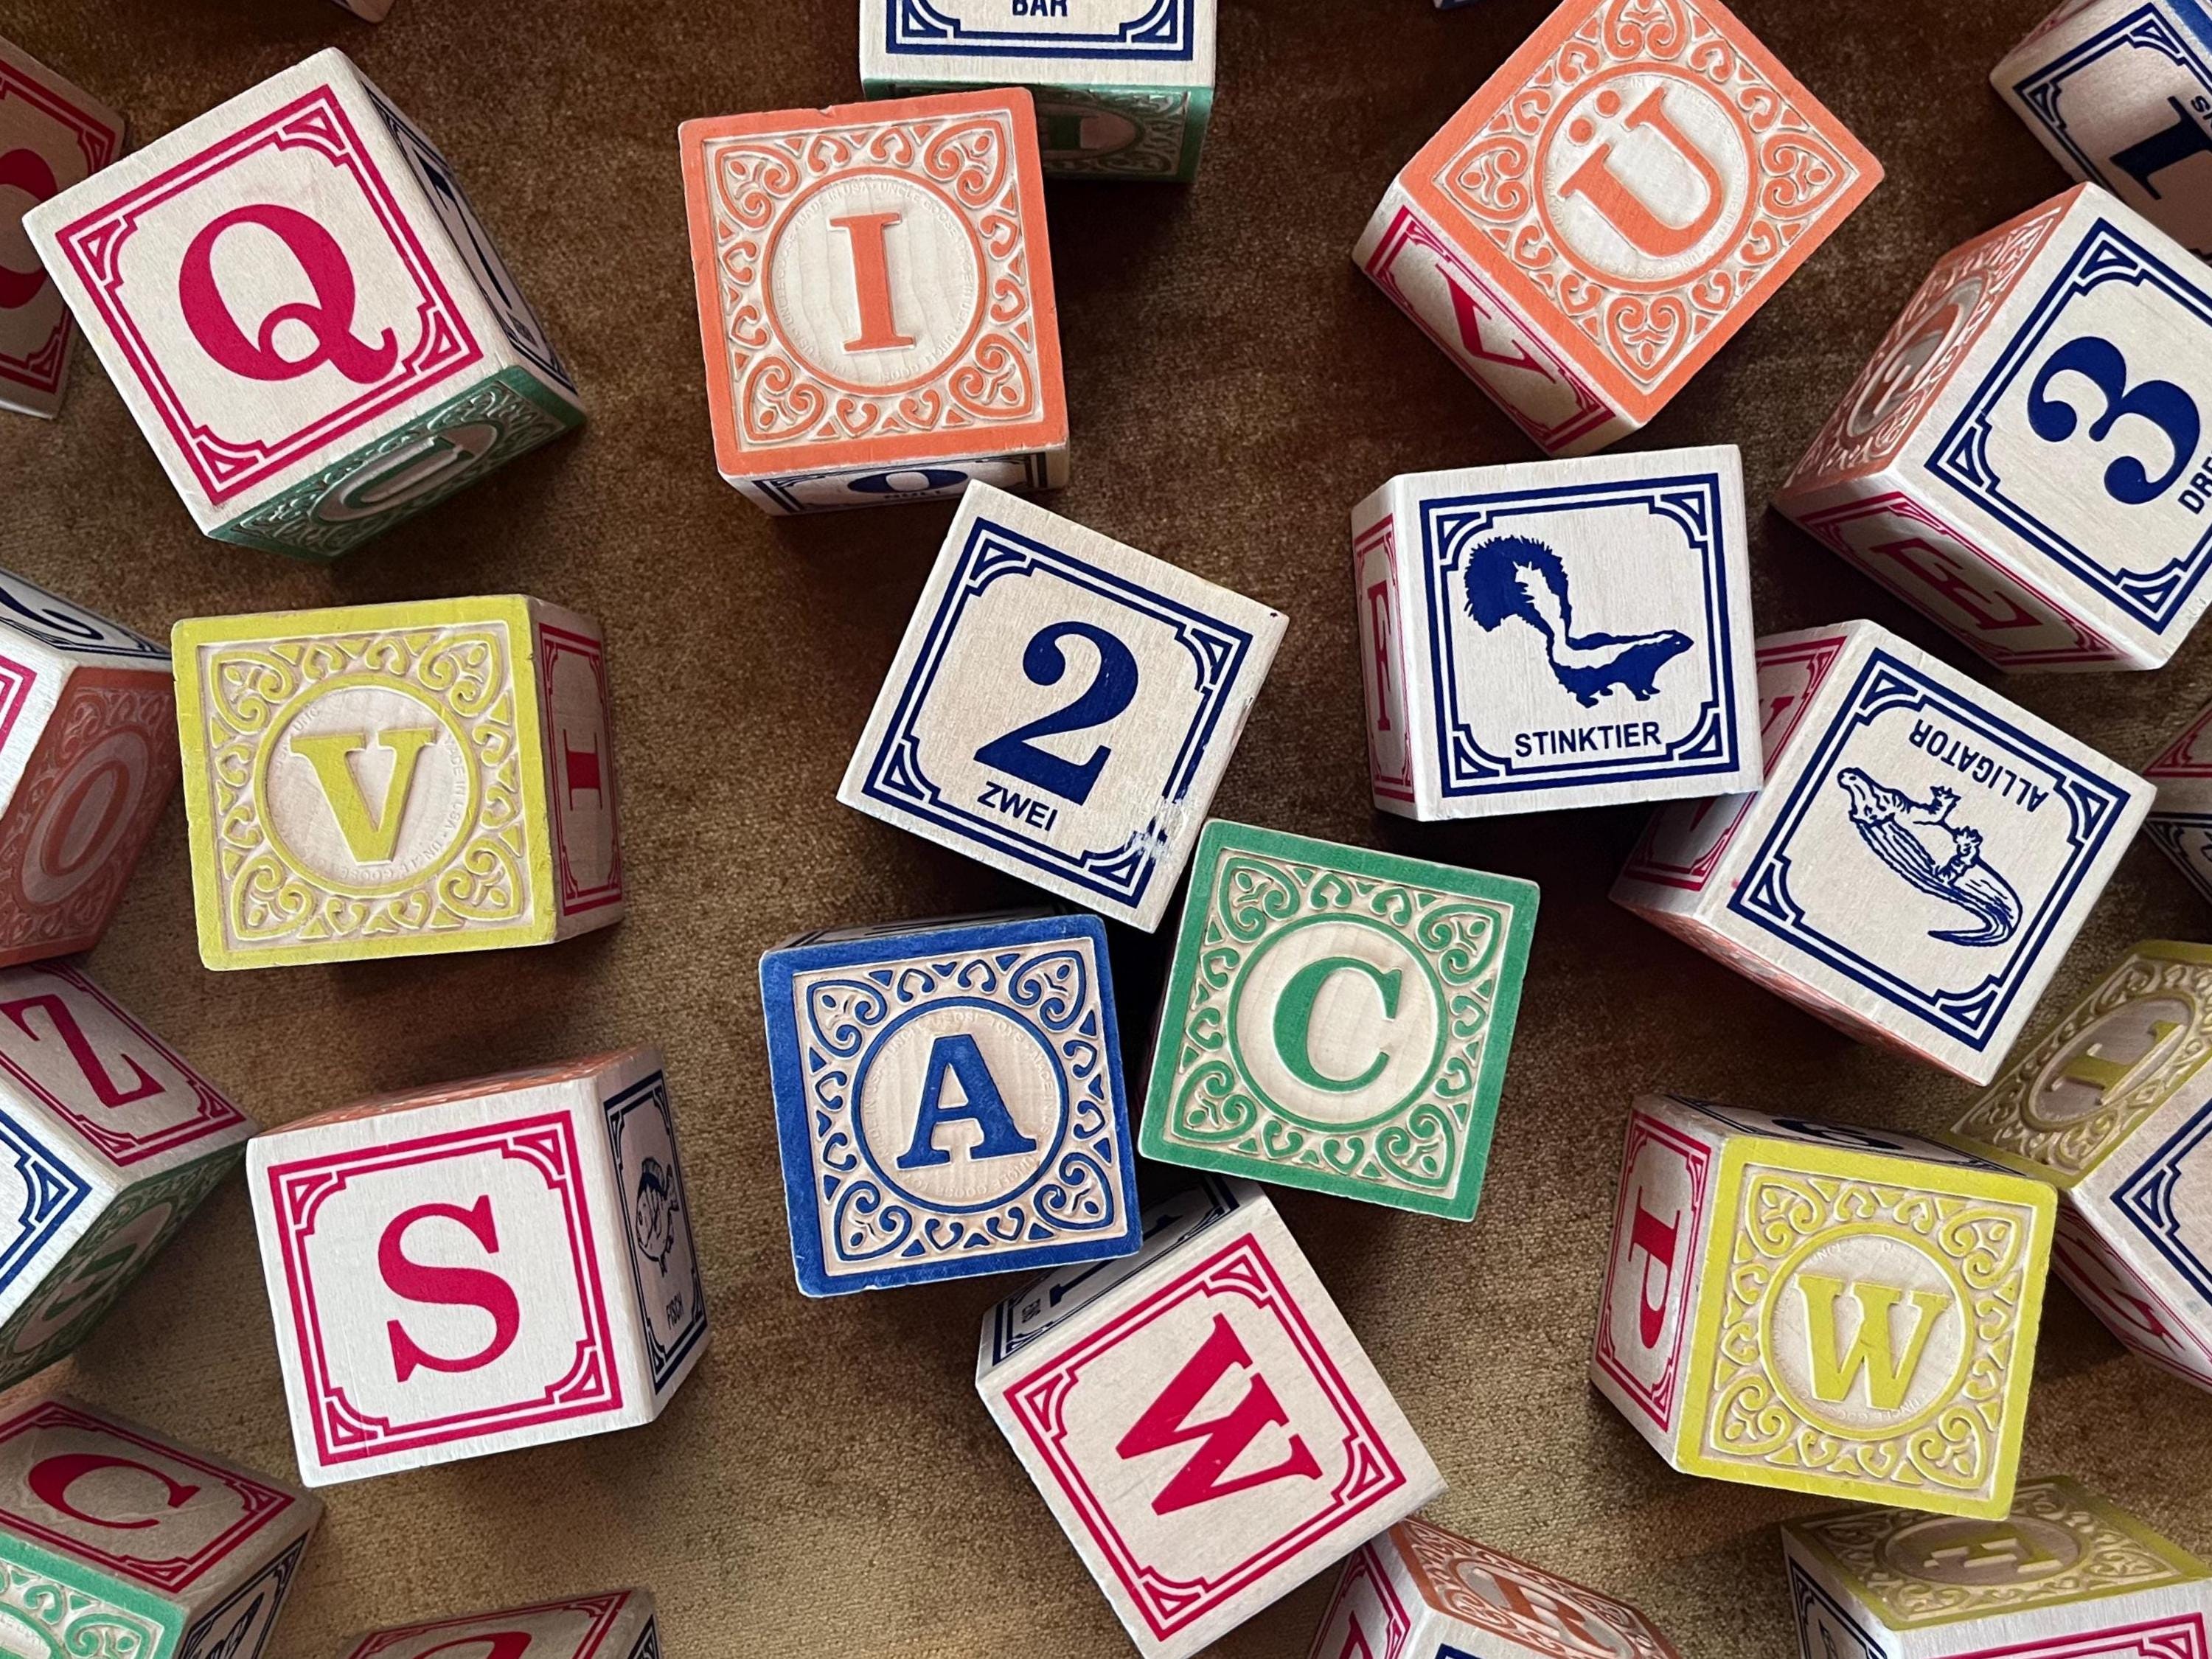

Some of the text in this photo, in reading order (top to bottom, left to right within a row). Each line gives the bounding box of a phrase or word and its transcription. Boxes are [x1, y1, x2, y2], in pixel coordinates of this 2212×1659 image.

[1558, 86, 1723, 257] Ü
[2110, 96, 2212, 201] 1
[178, 204, 398, 384] Q
[829, 212, 915, 353] I
[1436, 263, 1557, 384] Y
[2027, 336, 2200, 504] 3
[1868, 538, 2043, 630] E
[973, 621, 1138, 805] 2
[1367, 580, 1391, 731] F
[290, 727, 437, 865] V
[978, 782, 1057, 831] ZWEI
[1515, 721, 1662, 757] STINKTIER
[1909, 718, 2049, 812] ALLIGATOR
[0, 994, 166, 1109] Z
[1273, 957, 1402, 1093] C
[2052, 1020, 2185, 1105] T
[897, 1034, 1037, 1170] A
[378, 1194, 520, 1383] S
[1628, 1185, 1680, 1349] P
[1796, 1273, 1951, 1410] W
[1115, 1312, 1323, 1515] W
[28, 1453, 201, 1528] C
[1475, 1566, 1618, 1654] R
